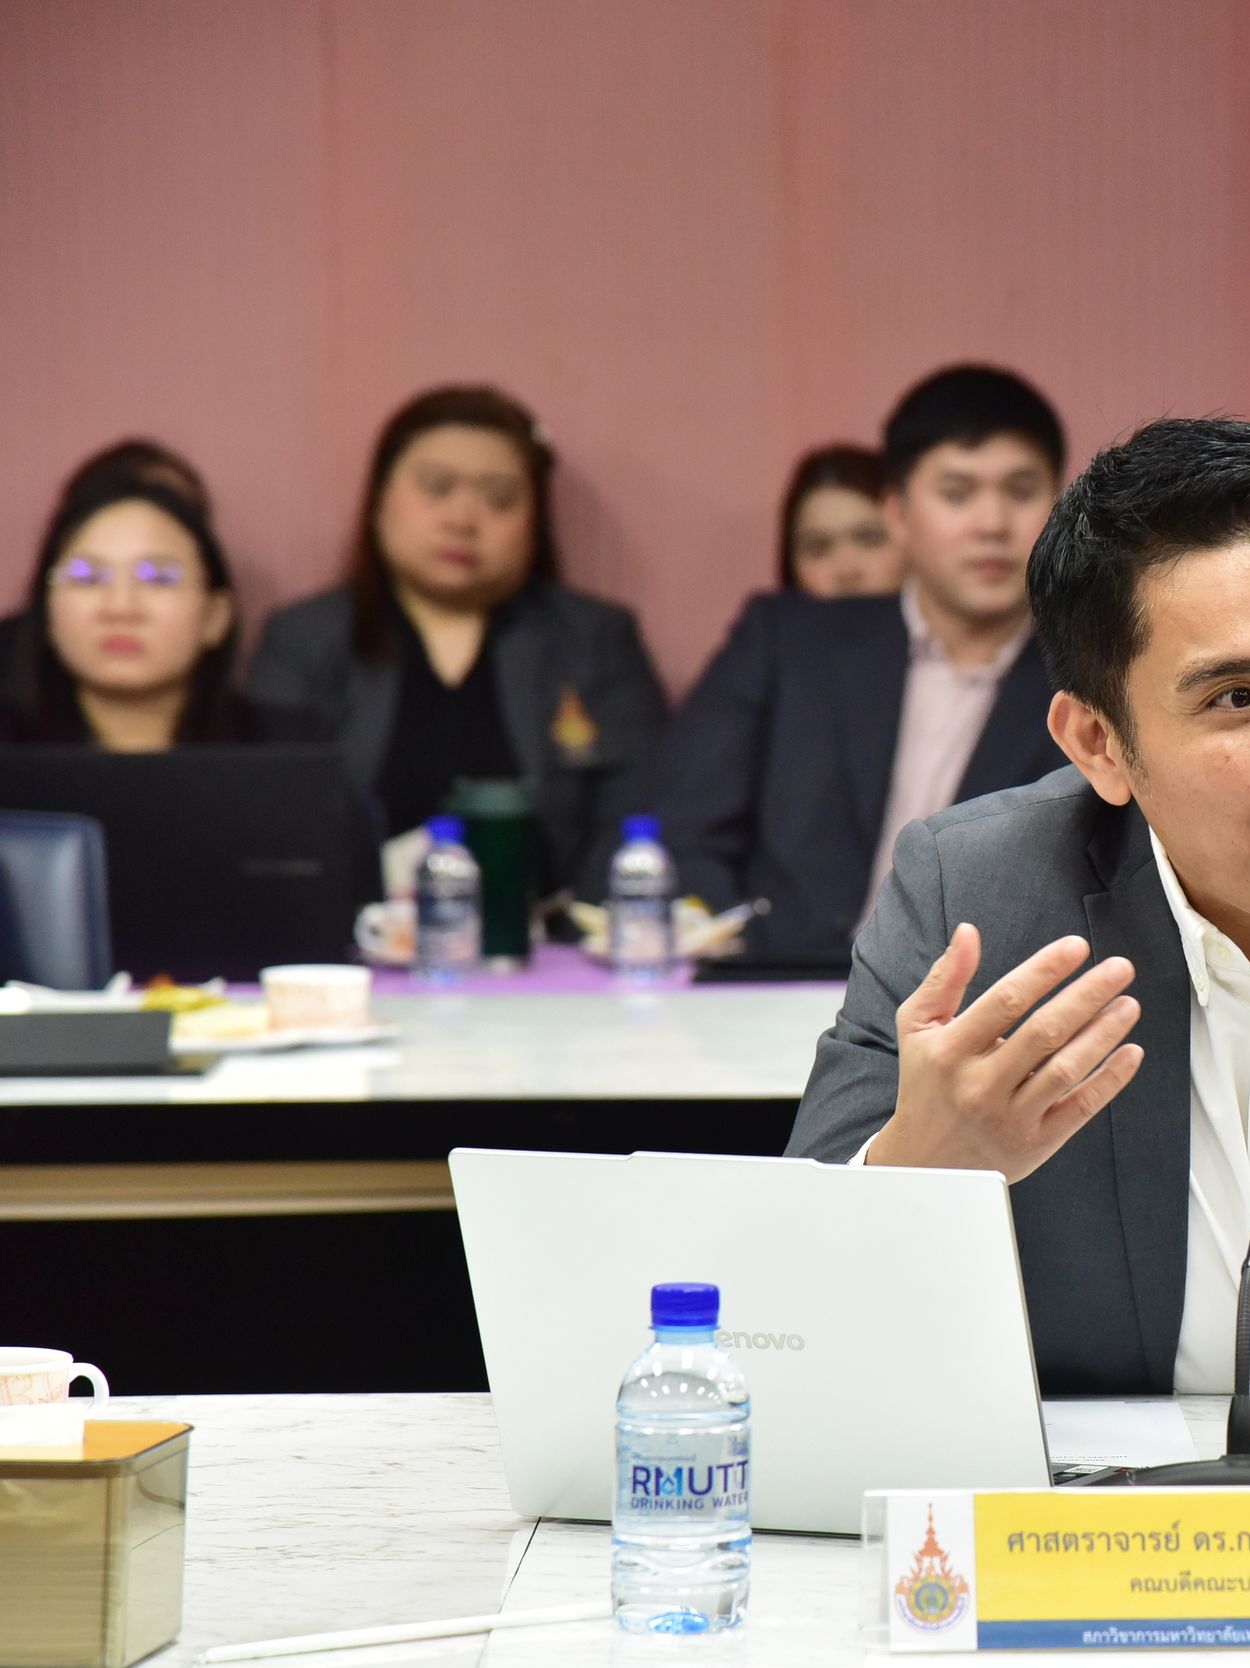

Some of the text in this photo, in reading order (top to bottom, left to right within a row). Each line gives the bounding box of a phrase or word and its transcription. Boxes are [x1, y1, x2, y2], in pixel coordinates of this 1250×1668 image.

[716, 1330, 806, 1352] enovo
[631, 1459, 749, 1497] RMUTT
[631, 1496, 705, 1510] DRINKING
[1007, 1519, 1181, 1552] ศาสตราจารย์
